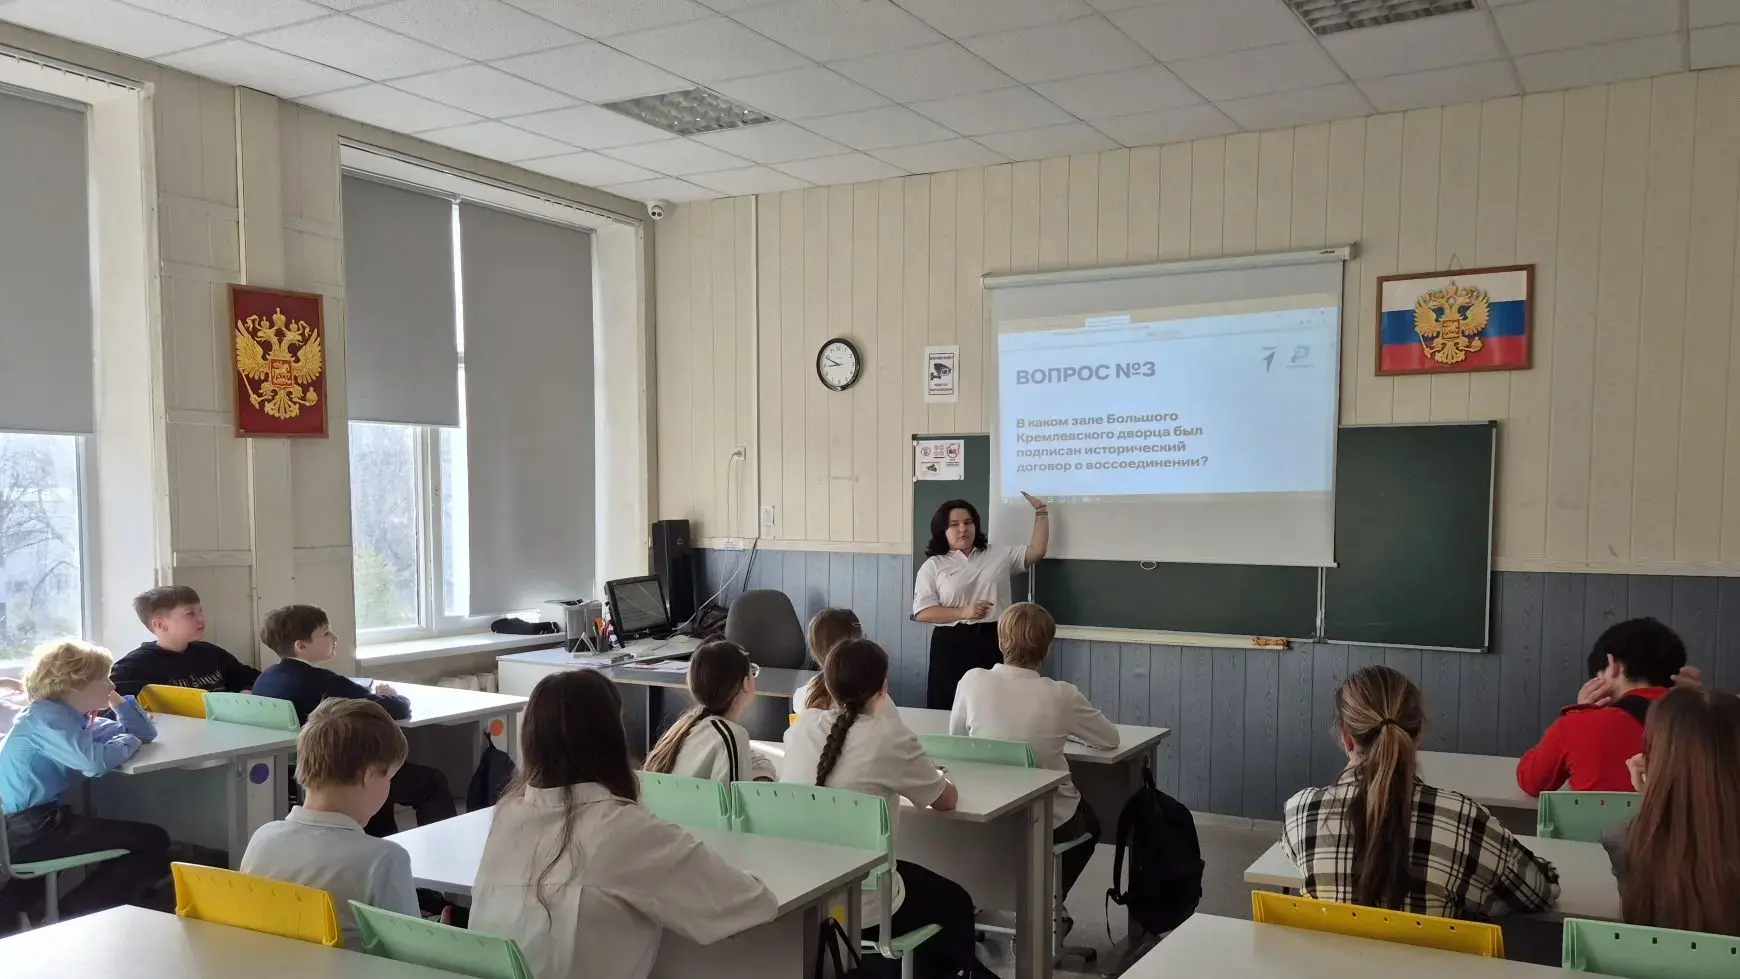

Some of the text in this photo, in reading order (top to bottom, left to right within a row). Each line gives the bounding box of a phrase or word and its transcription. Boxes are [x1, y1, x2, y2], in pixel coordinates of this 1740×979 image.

[1016, 361, 1156, 385] ВОПРОС №3
[1016, 412, 1178, 428] В каком зале Большого
[1016, 425, 1203, 445] Кремлевского дворца был
[1016, 441, 1186, 459] подписан исторический
[1016, 456, 1208, 473] договор о воссоединении?
